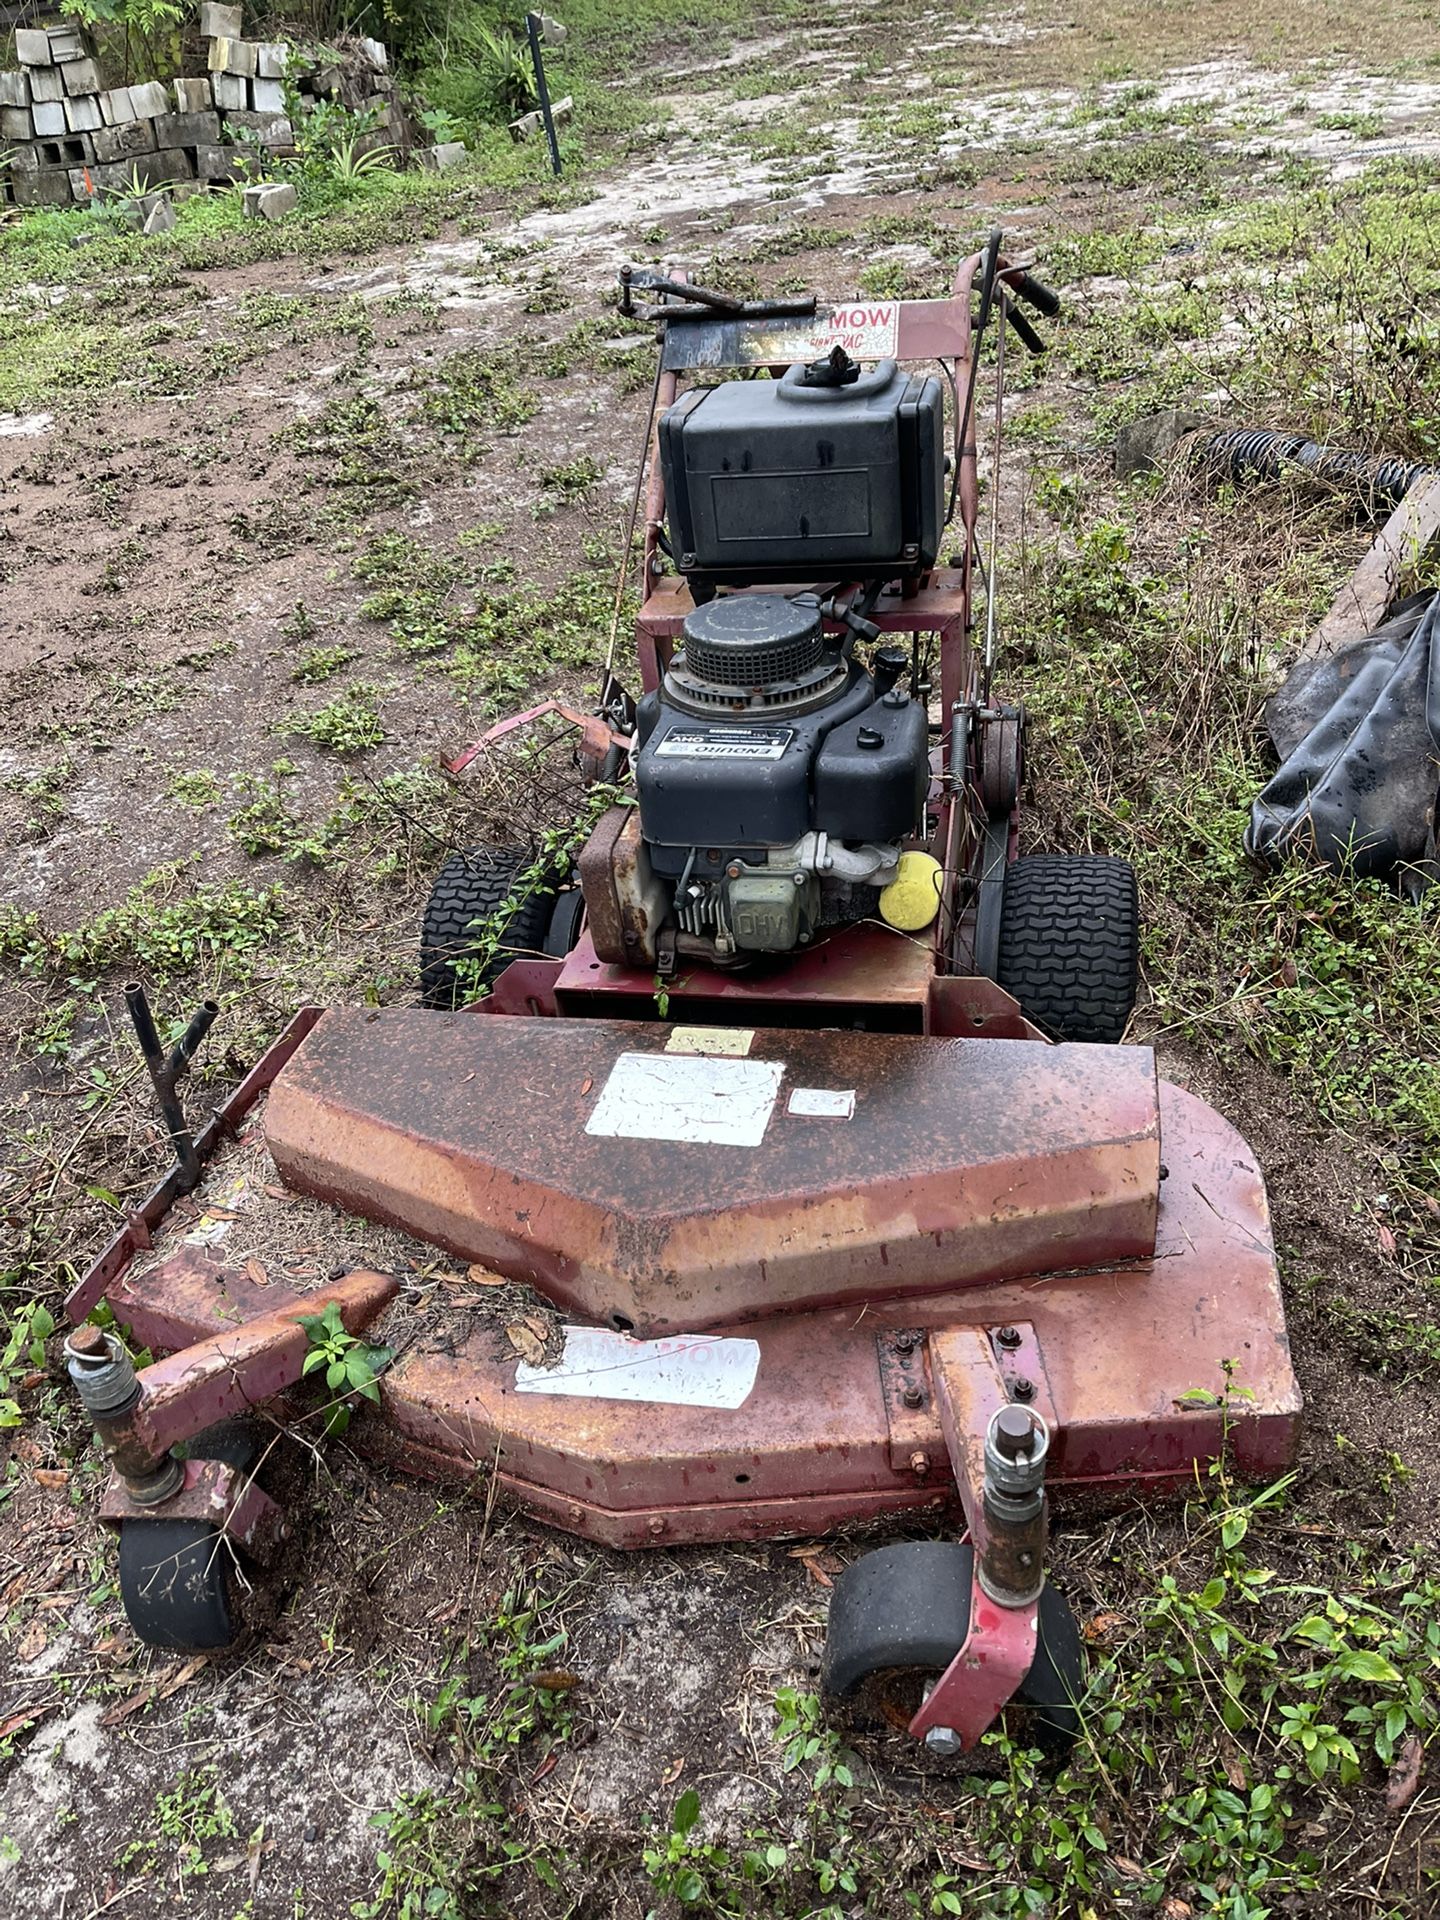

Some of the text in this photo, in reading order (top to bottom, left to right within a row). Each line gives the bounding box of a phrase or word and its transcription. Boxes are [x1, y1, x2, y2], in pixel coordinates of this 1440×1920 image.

[828, 308, 892, 329] MOW
[694, 745, 772, 755] ENDURO
[738, 913, 785, 936] OHV
